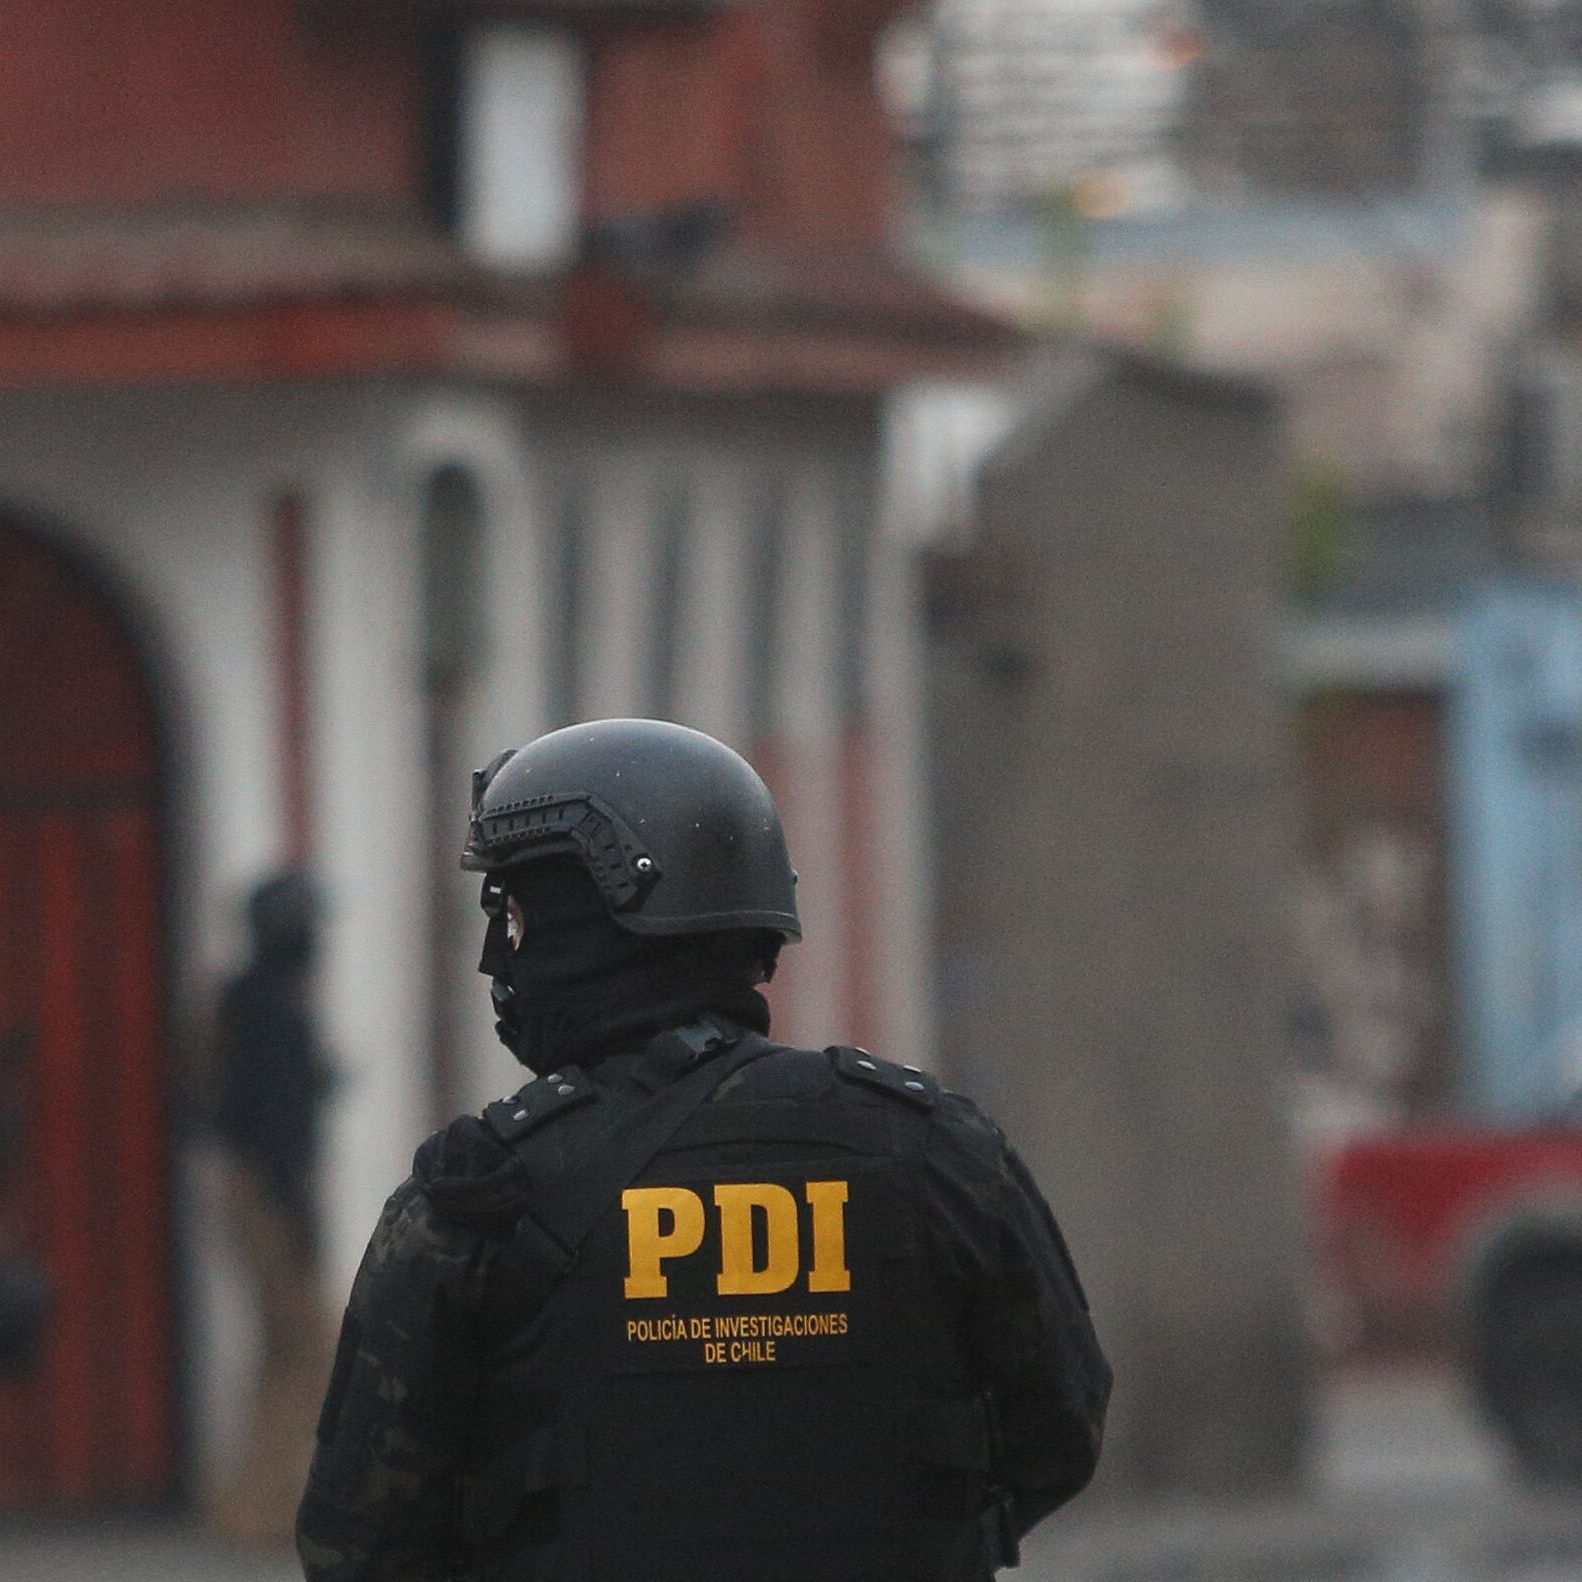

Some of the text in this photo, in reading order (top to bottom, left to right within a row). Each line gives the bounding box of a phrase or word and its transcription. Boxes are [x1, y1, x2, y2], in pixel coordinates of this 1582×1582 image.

[621, 1180, 851, 1300] PDI
[626, 1313, 849, 1343] POLICÍA DE INVESTIGACIONES
[704, 1341, 776, 1364] DE CHILE
